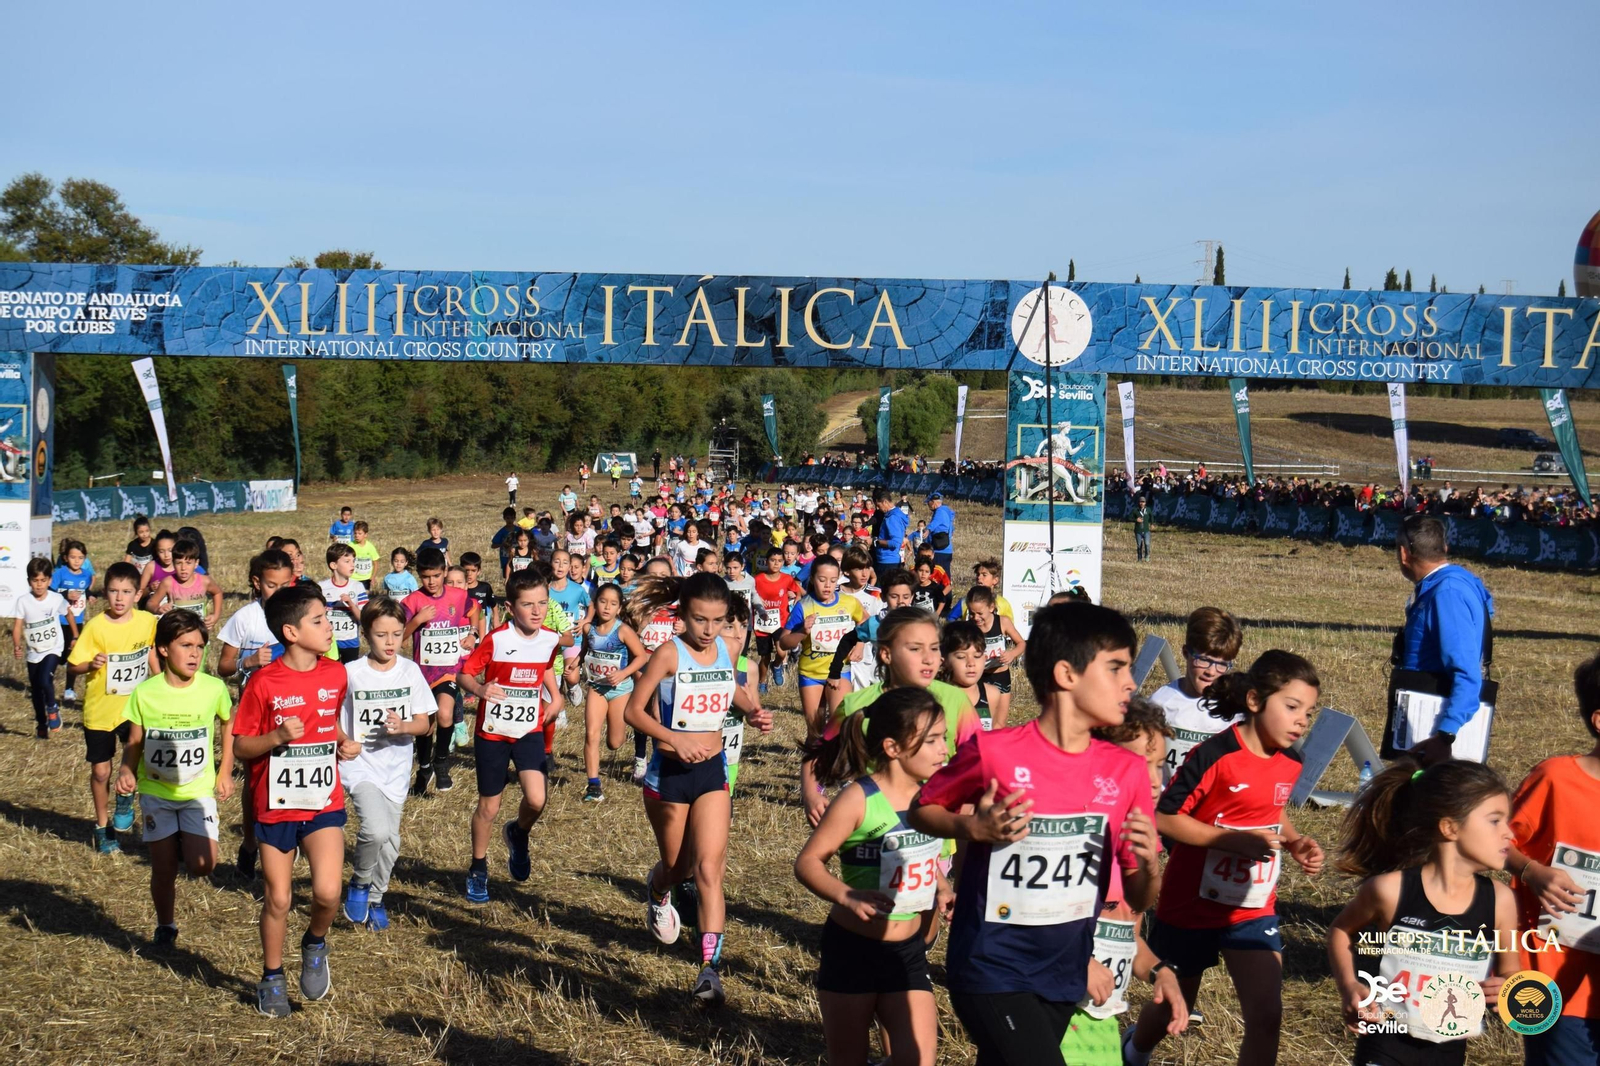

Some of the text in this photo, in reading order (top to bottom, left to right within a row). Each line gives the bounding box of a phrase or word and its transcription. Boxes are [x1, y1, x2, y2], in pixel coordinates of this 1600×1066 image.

[65, 293, 87, 305] DE
[89, 292, 183, 307] ANDALUCÍA
[246, 281, 410, 336] XLIII
[413, 285, 541, 317] CROSS
[0, 305, 147, 321] E CAMPO A TRAVÉS
[600, 275, 912, 350] ITÁLICA
[1308, 302, 1438, 338] CROSS
[25, 320, 116, 334] POR CLUBES
[413, 320, 588, 339] INTERNACIONAL
[1137, 296, 1304, 354] XLIII
[245, 339, 557, 359] INTERNATIONAL CROSS COUNTRY
[1308, 337, 1485, 361] INTERNACIONAL
[1136, 355, 1453, 380] INTERNATIONAL CROSS COUNTRY
[1058, 390, 1094, 400] Sevilla
[1059, 383, 1094, 391] Diputación
[30, 627, 57, 643] 4268
[430, 620, 450, 630] XXVI
[424, 641, 459, 655] 4325
[112, 662, 146, 682] 4275
[695, 672, 722, 681] ITÁLICA
[370, 690, 398, 699] ITÁLICA
[681, 692, 729, 714] 4381
[490, 703, 536, 723] 4328
[164, 731, 194, 740] ITÁLICA
[151, 747, 205, 768] 4249
[291, 745, 324, 757] ITÁLICA
[277, 765, 333, 789] 4140
[1000, 851, 1095, 890] 4247
[1212, 855, 1276, 884] 4517
[1400, 916, 1427, 927] 42K
